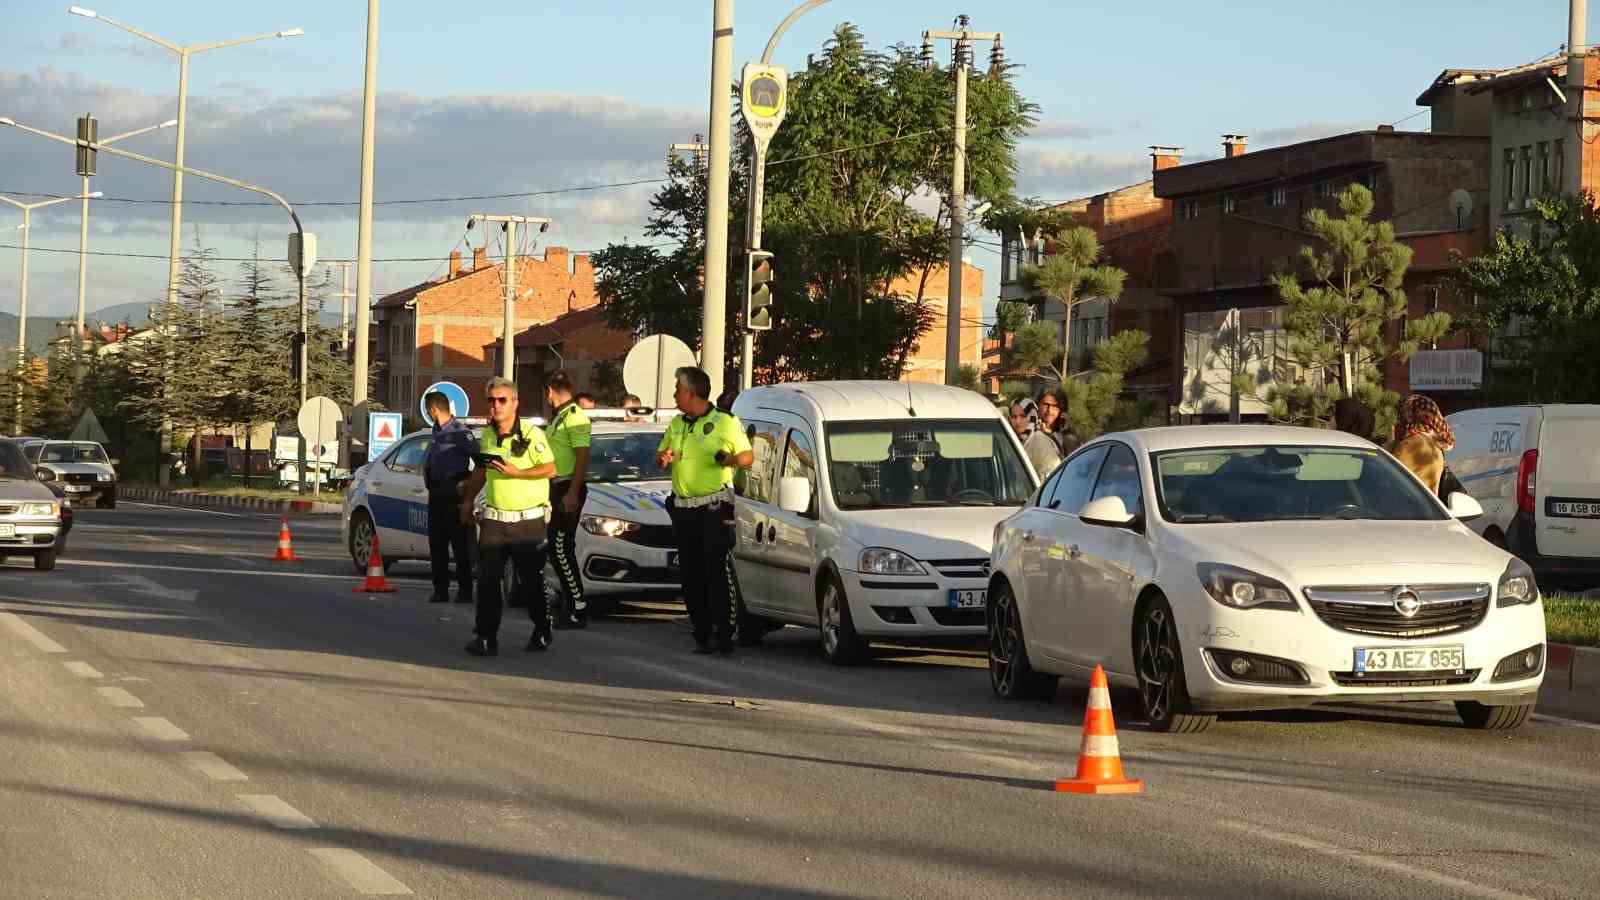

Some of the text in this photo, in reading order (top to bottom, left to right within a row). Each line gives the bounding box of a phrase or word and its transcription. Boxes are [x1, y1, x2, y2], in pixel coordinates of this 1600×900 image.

[1490, 430, 1514, 453] BEK
[1558, 502, 1568, 513] 16
[1570, 503, 1588, 514] ASB
[958, 591, 973, 606] 43
[1366, 651, 1388, 669] 43
[1392, 650, 1426, 669] AEZ
[1430, 649, 1462, 668] 855
